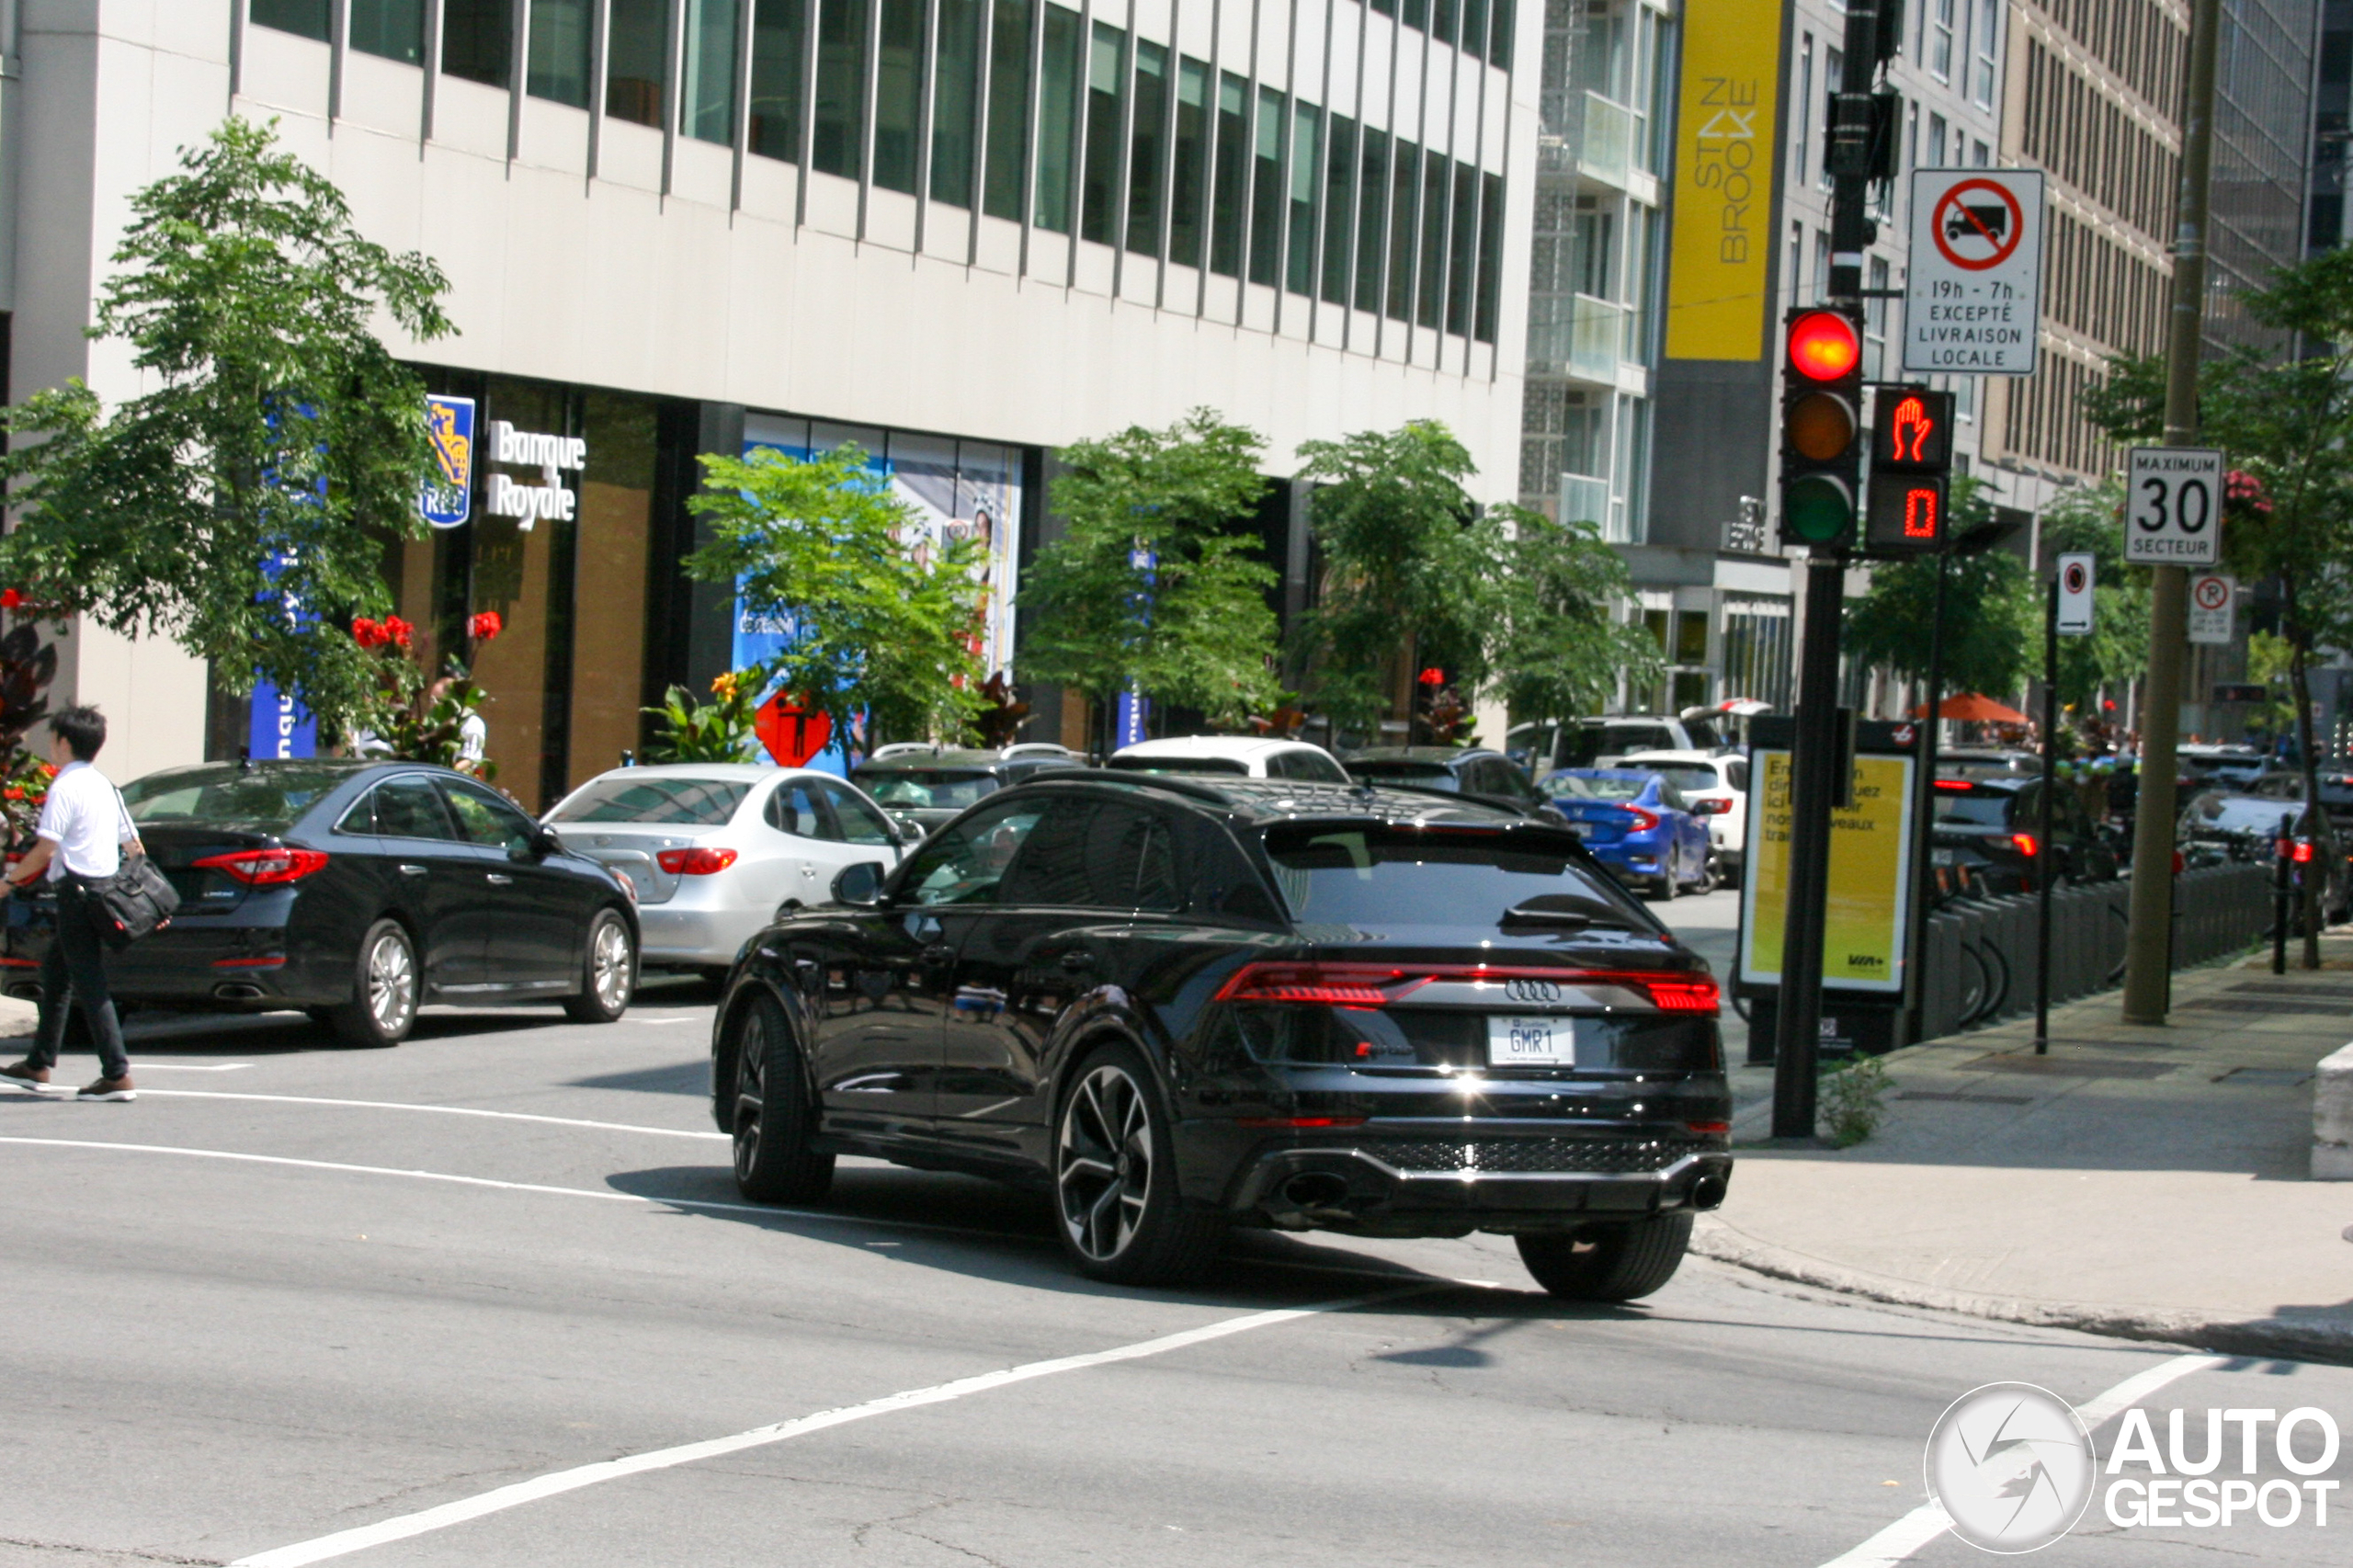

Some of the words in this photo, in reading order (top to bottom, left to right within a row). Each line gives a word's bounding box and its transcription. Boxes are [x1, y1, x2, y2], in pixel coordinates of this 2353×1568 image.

[1721, 77, 1758, 264] BROOKE
[1932, 280, 1963, 299] 19h
[1990, 281, 2013, 300] 7h
[1930, 302, 2013, 323] EXCEPTÉ
[1919, 327, 2021, 345] LIVRAISON
[1931, 349, 2005, 366] LOCALE
[490, 420, 586, 481] Banque
[2136, 456, 2215, 472] MAXIMUM
[488, 473, 576, 531] Royale
[2137, 477, 2210, 534] 30
[2133, 538, 2209, 553] SECTEUR
[1510, 1028, 1552, 1053] GMR1
